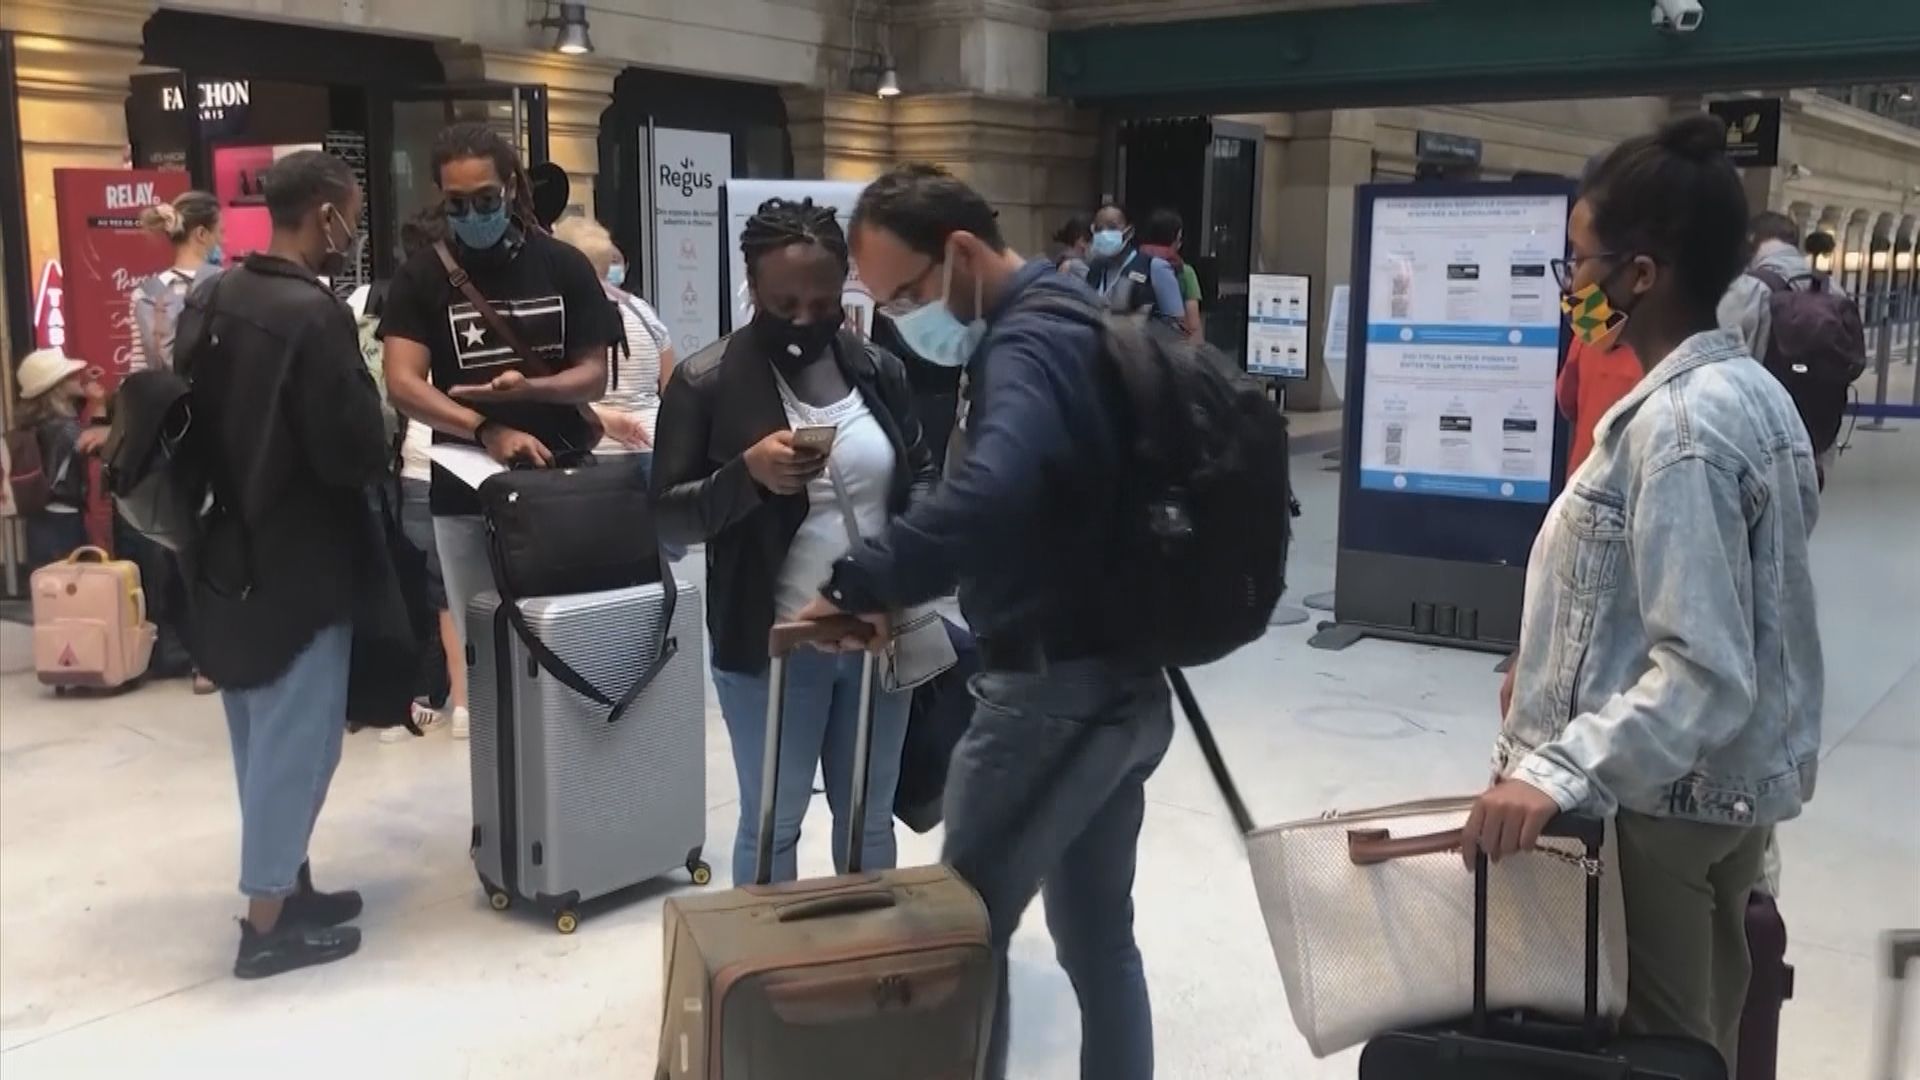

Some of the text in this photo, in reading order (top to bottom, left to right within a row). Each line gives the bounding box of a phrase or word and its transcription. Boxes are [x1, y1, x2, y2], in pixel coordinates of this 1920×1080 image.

[163, 80, 250, 111] FACHON
[106, 181, 154, 209] RELAY
[659, 163, 713, 197] Regus
